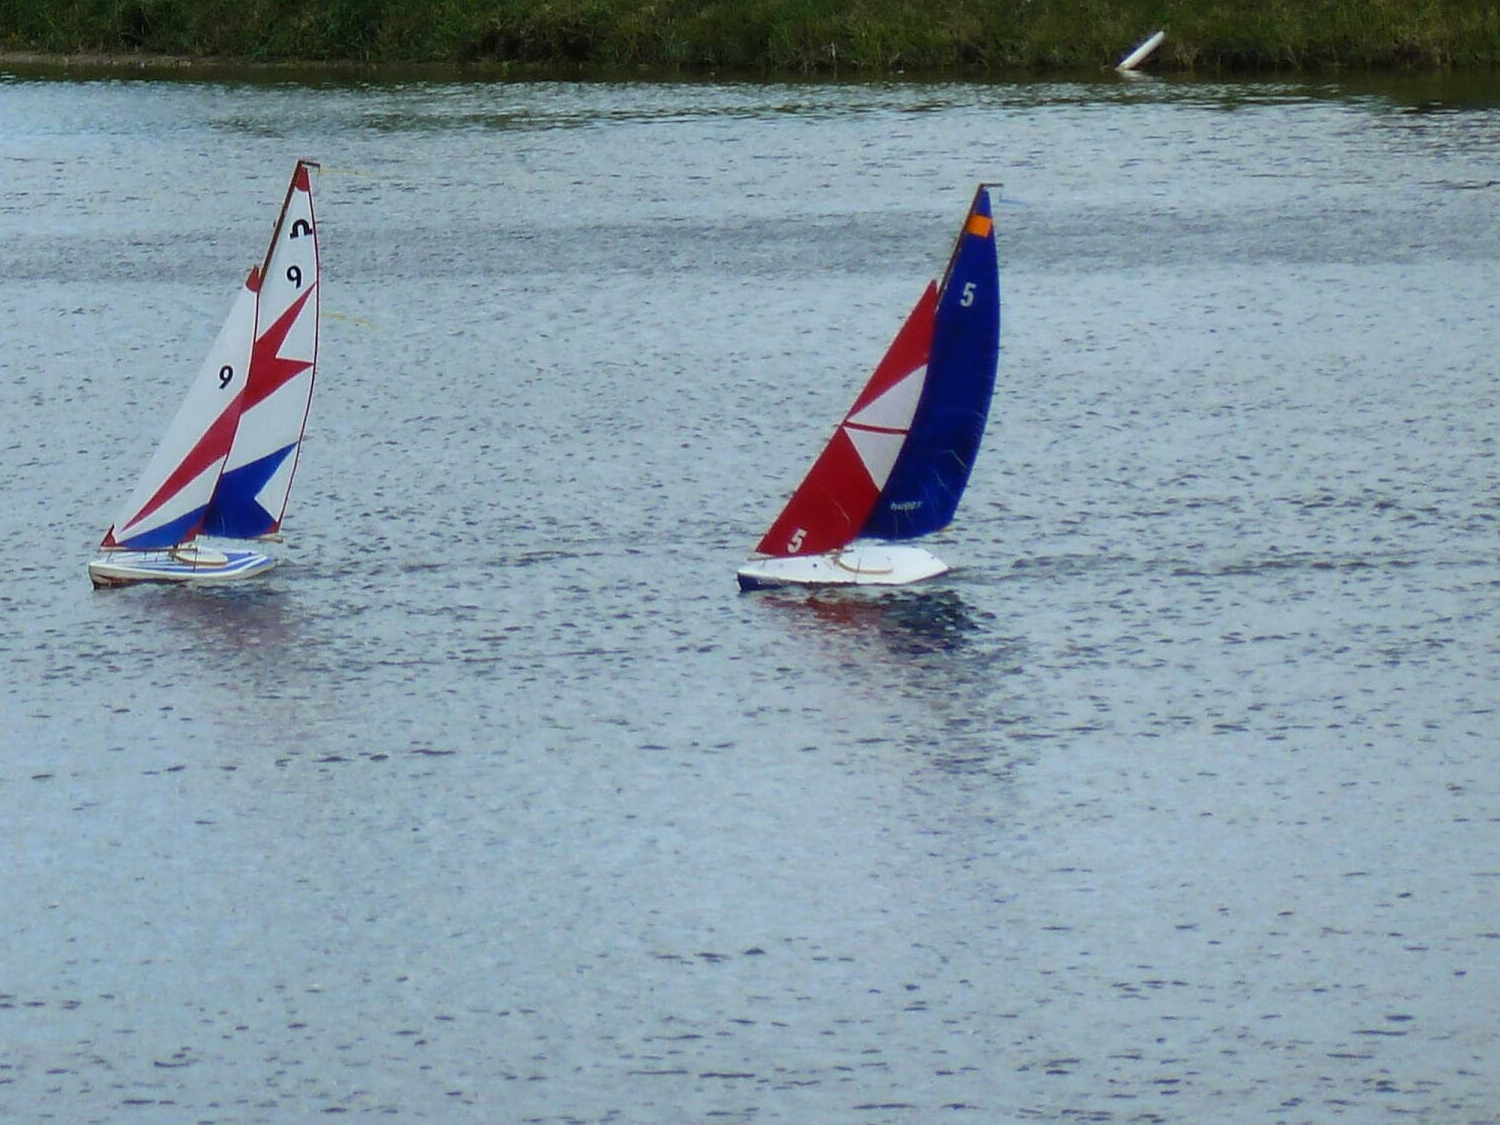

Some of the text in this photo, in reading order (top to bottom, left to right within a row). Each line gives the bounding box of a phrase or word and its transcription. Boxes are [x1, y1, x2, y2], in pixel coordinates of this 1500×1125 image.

[286, 265, 302, 289] 9
[960, 282, 977, 307] 5
[219, 365, 234, 390] 9
[787, 528, 807, 554] 5
